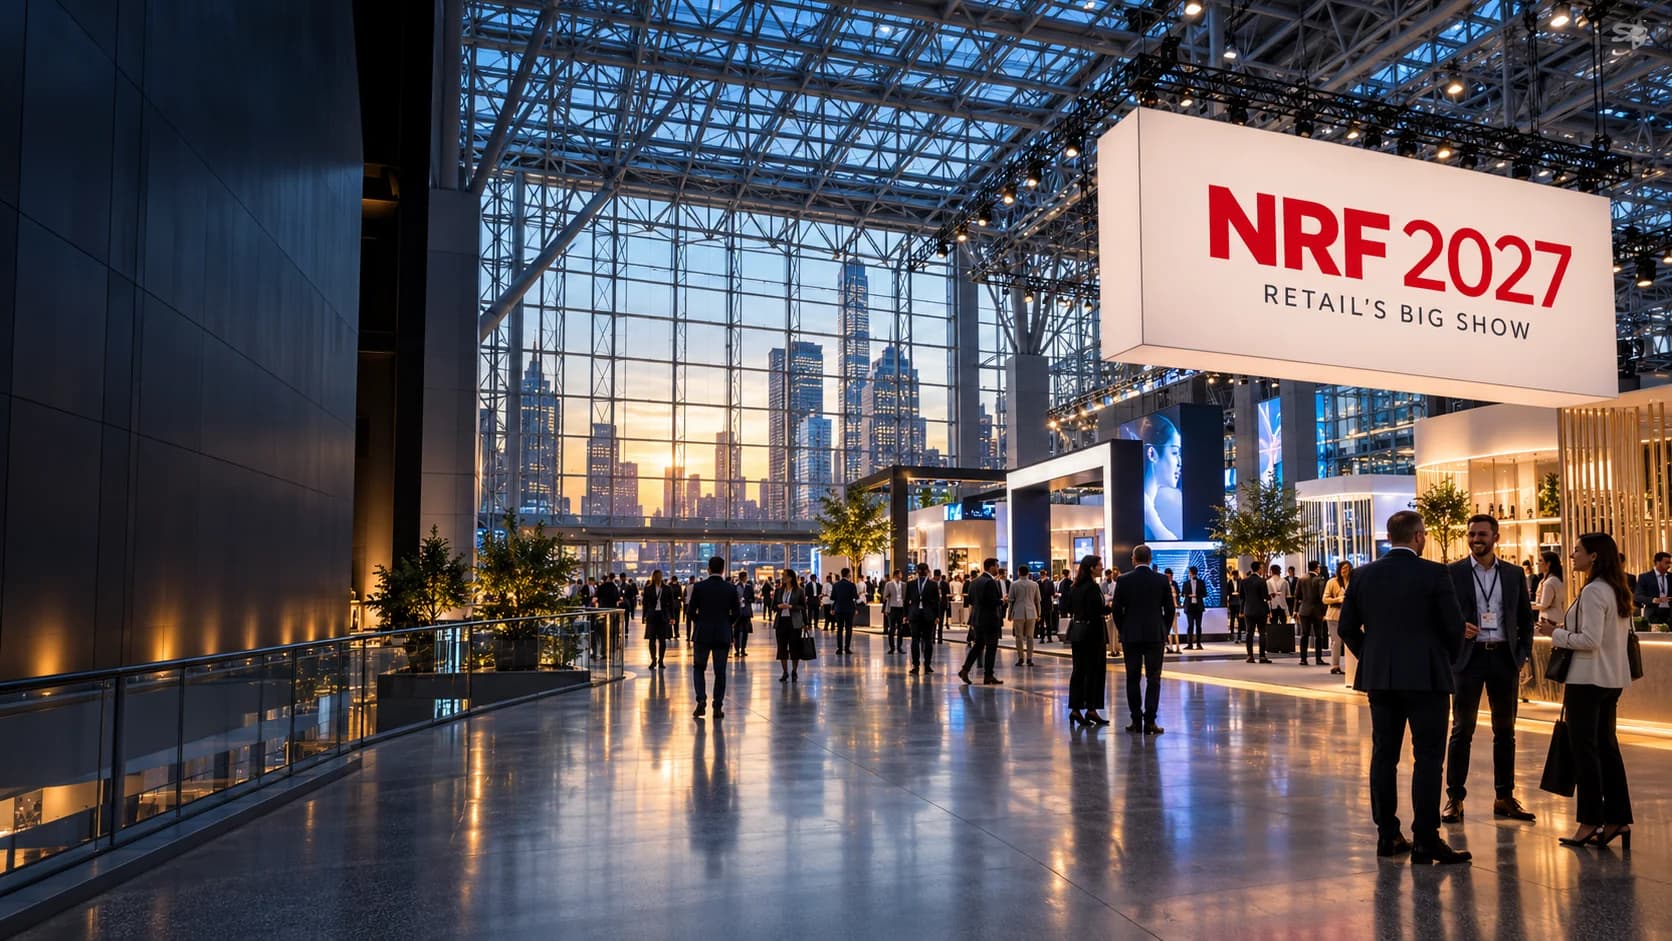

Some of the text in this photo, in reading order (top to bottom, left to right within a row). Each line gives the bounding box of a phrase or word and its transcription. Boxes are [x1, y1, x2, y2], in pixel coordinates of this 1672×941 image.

[1208, 184, 1573, 309] NRF 2027
[1264, 284, 1531, 340] RETAIL'S BIG SHOW
